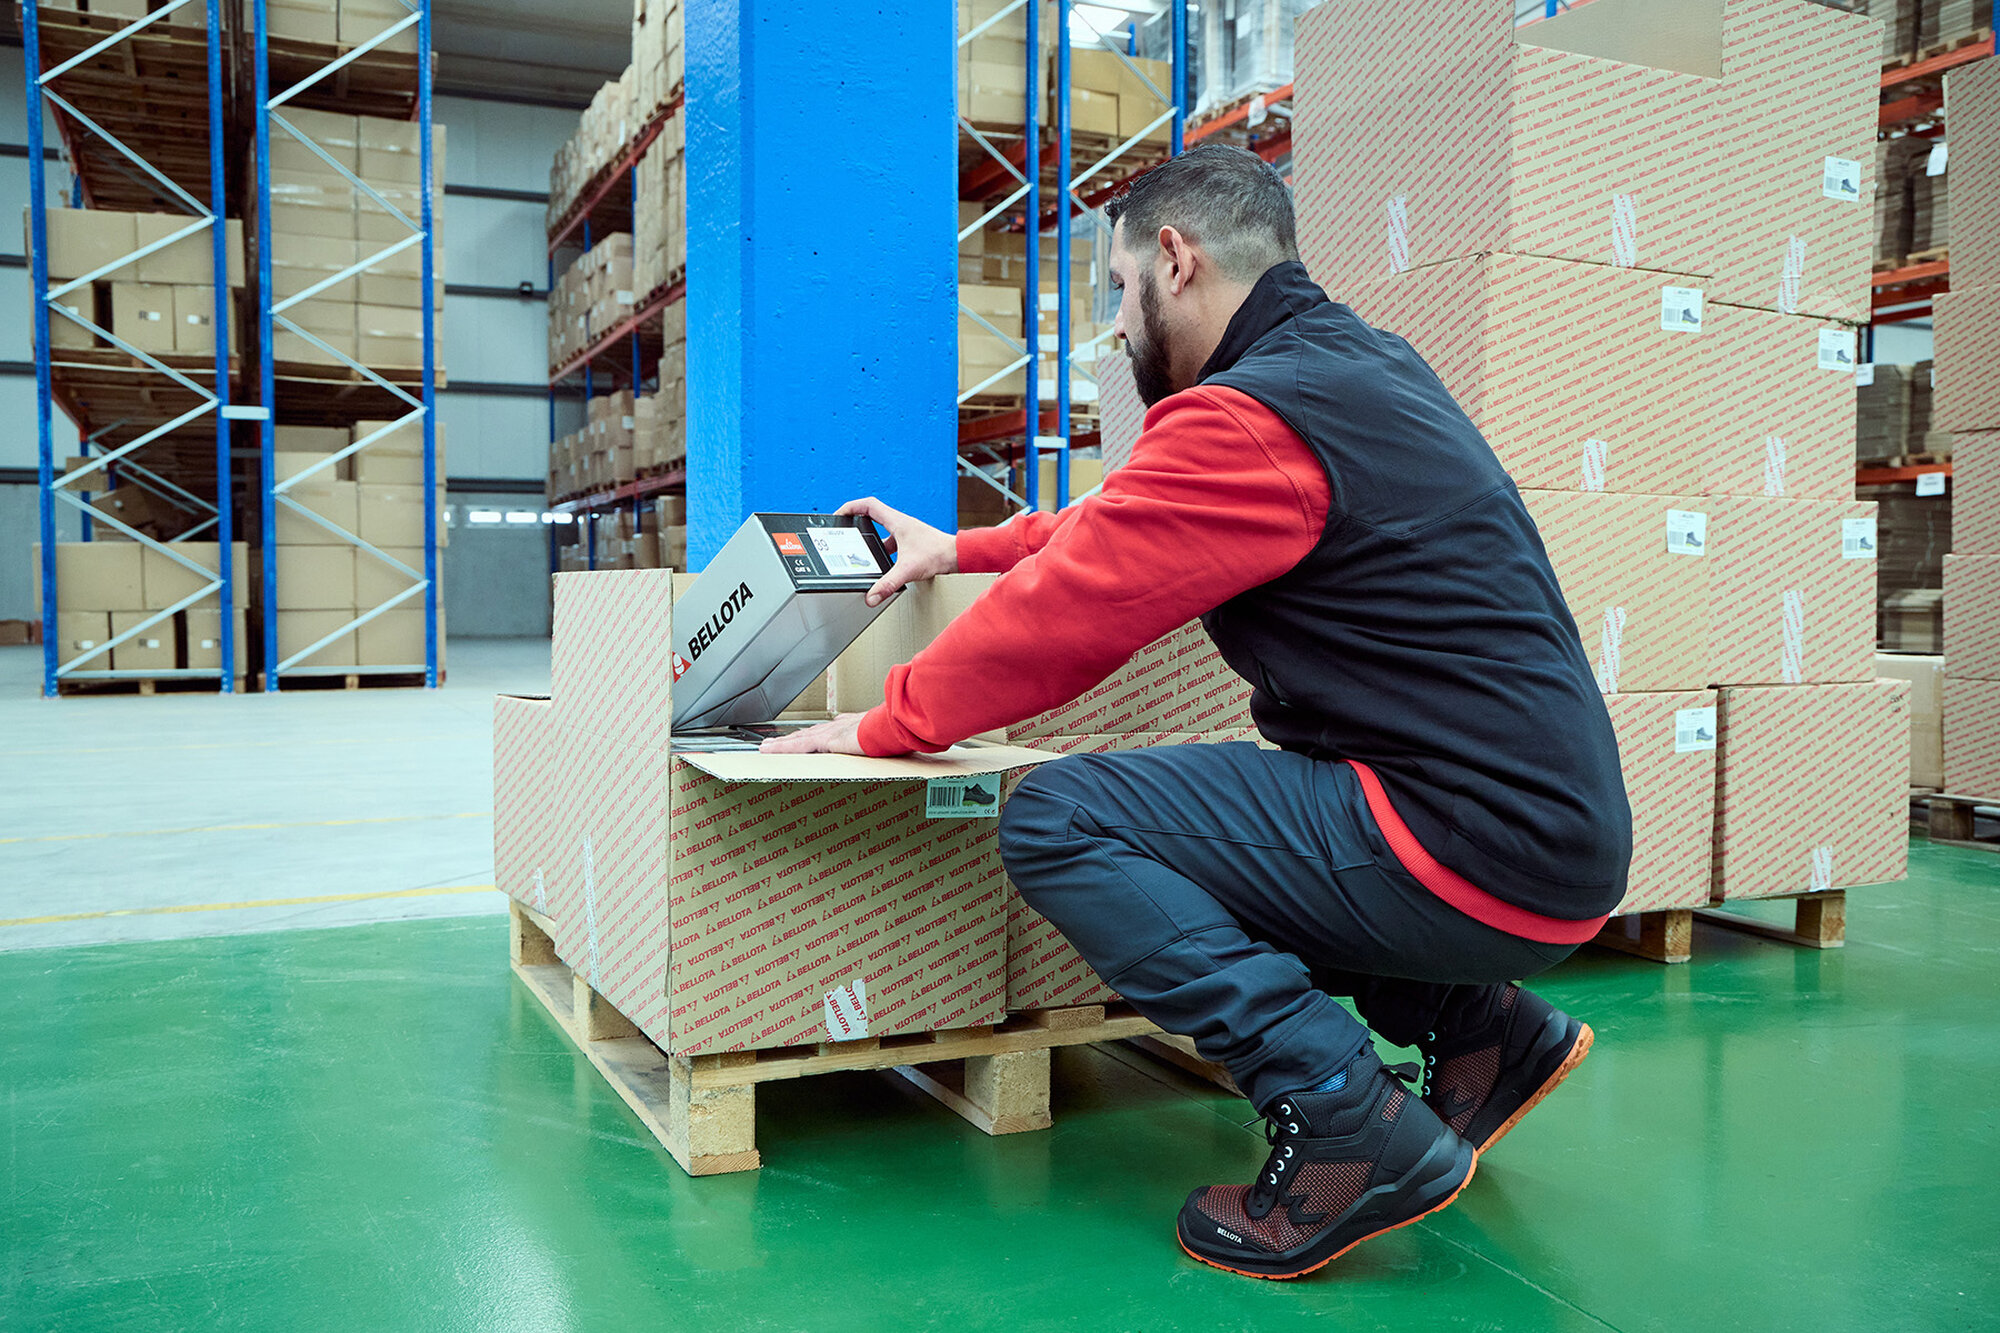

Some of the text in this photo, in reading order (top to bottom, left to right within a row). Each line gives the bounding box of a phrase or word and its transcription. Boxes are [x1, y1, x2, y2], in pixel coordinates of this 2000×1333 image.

[814, 539, 829, 551] 39
[688, 582, 754, 662] BELLOTA
[1142, 636, 1171, 654] BELLOTA
[1049, 700, 1080, 720] BELLOTA
[1093, 679, 1122, 698] BELLOTA
[1135, 659, 1164, 678] BELLOTA
[1177, 639, 1205, 657] BELLOTA
[1152, 668, 1181, 687] BELLOTA
[1110, 688, 1139, 707] BELLOTA
[1204, 680, 1231, 699] BELLOTA
[1060, 671, 1215, 752] BELLOTA BELLOTA BELLOTA BELLOTA
[1067, 709, 1097, 729] BELLOTA
[1162, 700, 1190, 719] BELLOTA
[1120, 721, 1149, 740] BELLOTA
[1155, 723, 1183, 742] BELLOTA
[1197, 703, 1224, 722] BELLOTA
[1213, 712, 1240, 730] BELLOTA
[746, 783, 782, 805] BELLOTA
[671, 796, 708, 818] BELLOTA
[694, 807, 730, 829] BELLOTA
[812, 796, 846, 818] BELLOTA
[686, 786, 825, 856] BELLOTA BELLOTA BELLOTA
[761, 820, 796, 842] BELLOTA
[701, 871, 738, 893] BELLOTA
[753, 846, 789, 868] BELLOTA
[804, 822, 839, 844] BELLOTA
[854, 799, 888, 820] BELLOTA
[709, 844, 745, 866] BELLOTA
[671, 809, 908, 928] BELLOTA BELLOTA BELLOTA BELLOTA BELLOTA
[668, 932, 701, 953] ELLOTA
[716, 907, 752, 930] BELLOTA
[768, 882, 803, 905] BELLOTA
[818, 858, 853, 880] BELLOTA
[868, 835, 901, 856] BELLOTA
[687, 821, 968, 965] BELLOTA BELLOTA BELLOTA BELLOTA BELLOTA BELLOTA
[961, 890, 992, 911] BELLOTA
[679, 969, 716, 992] BELLOTA
[732, 944, 767, 966] BELLOTA
[782, 918, 817, 941] BELLOTA
[832, 894, 866, 916] BELLOTA
[881, 870, 914, 891] BELLOTA
[928, 847, 960, 868] BELLOTA
[702, 856, 980, 1002] BELLOTA BELLOTA BELLOTA BELLOTA BELLOTA BELLOTA
[914, 914, 947, 935] BELLOTA
[694, 1005, 731, 1029] BELLOTA
[746, 979, 781, 1002] BELLOTA
[797, 954, 831, 976] BELLOTA
[846, 929, 880, 951] BELLOTA
[894, 905, 927, 926] BELLOTA
[941, 881, 973, 902] BELLOTA
[867, 938, 900, 960] BELLOTA
[928, 948, 959, 970] BELLOTA
[1040, 943, 1069, 964] BELLOTA
[761, 1015, 796, 1038] BELLOTA
[907, 939, 940, 961] BELLOTA
[954, 915, 985, 937] BELLOTA
[818, 963, 852, 985] BELLOTA
[873, 949, 998, 1021] BELLOTA BELLOTA BELLOTA
[880, 973, 913, 995] BELLOTA
[940, 982, 972, 1004] BELLOTA
[1016, 975, 1046, 996] BELLOTA
[1052, 975, 1082, 996] BELLOTA
[1071, 983, 1100, 1004] BELLOTA
[768, 988, 803, 1011] BELLOTA
[717, 1014, 753, 1038] BELLOTA
[829, 999, 850, 1034] BELLOTA
[894, 1007, 926, 1029] BELLOTA
[934, 1007, 965, 1029] BELLOTA
[783, 1024, 817, 1046] BELLOTA
[1217, 1226, 1242, 1244] BELLOTA
